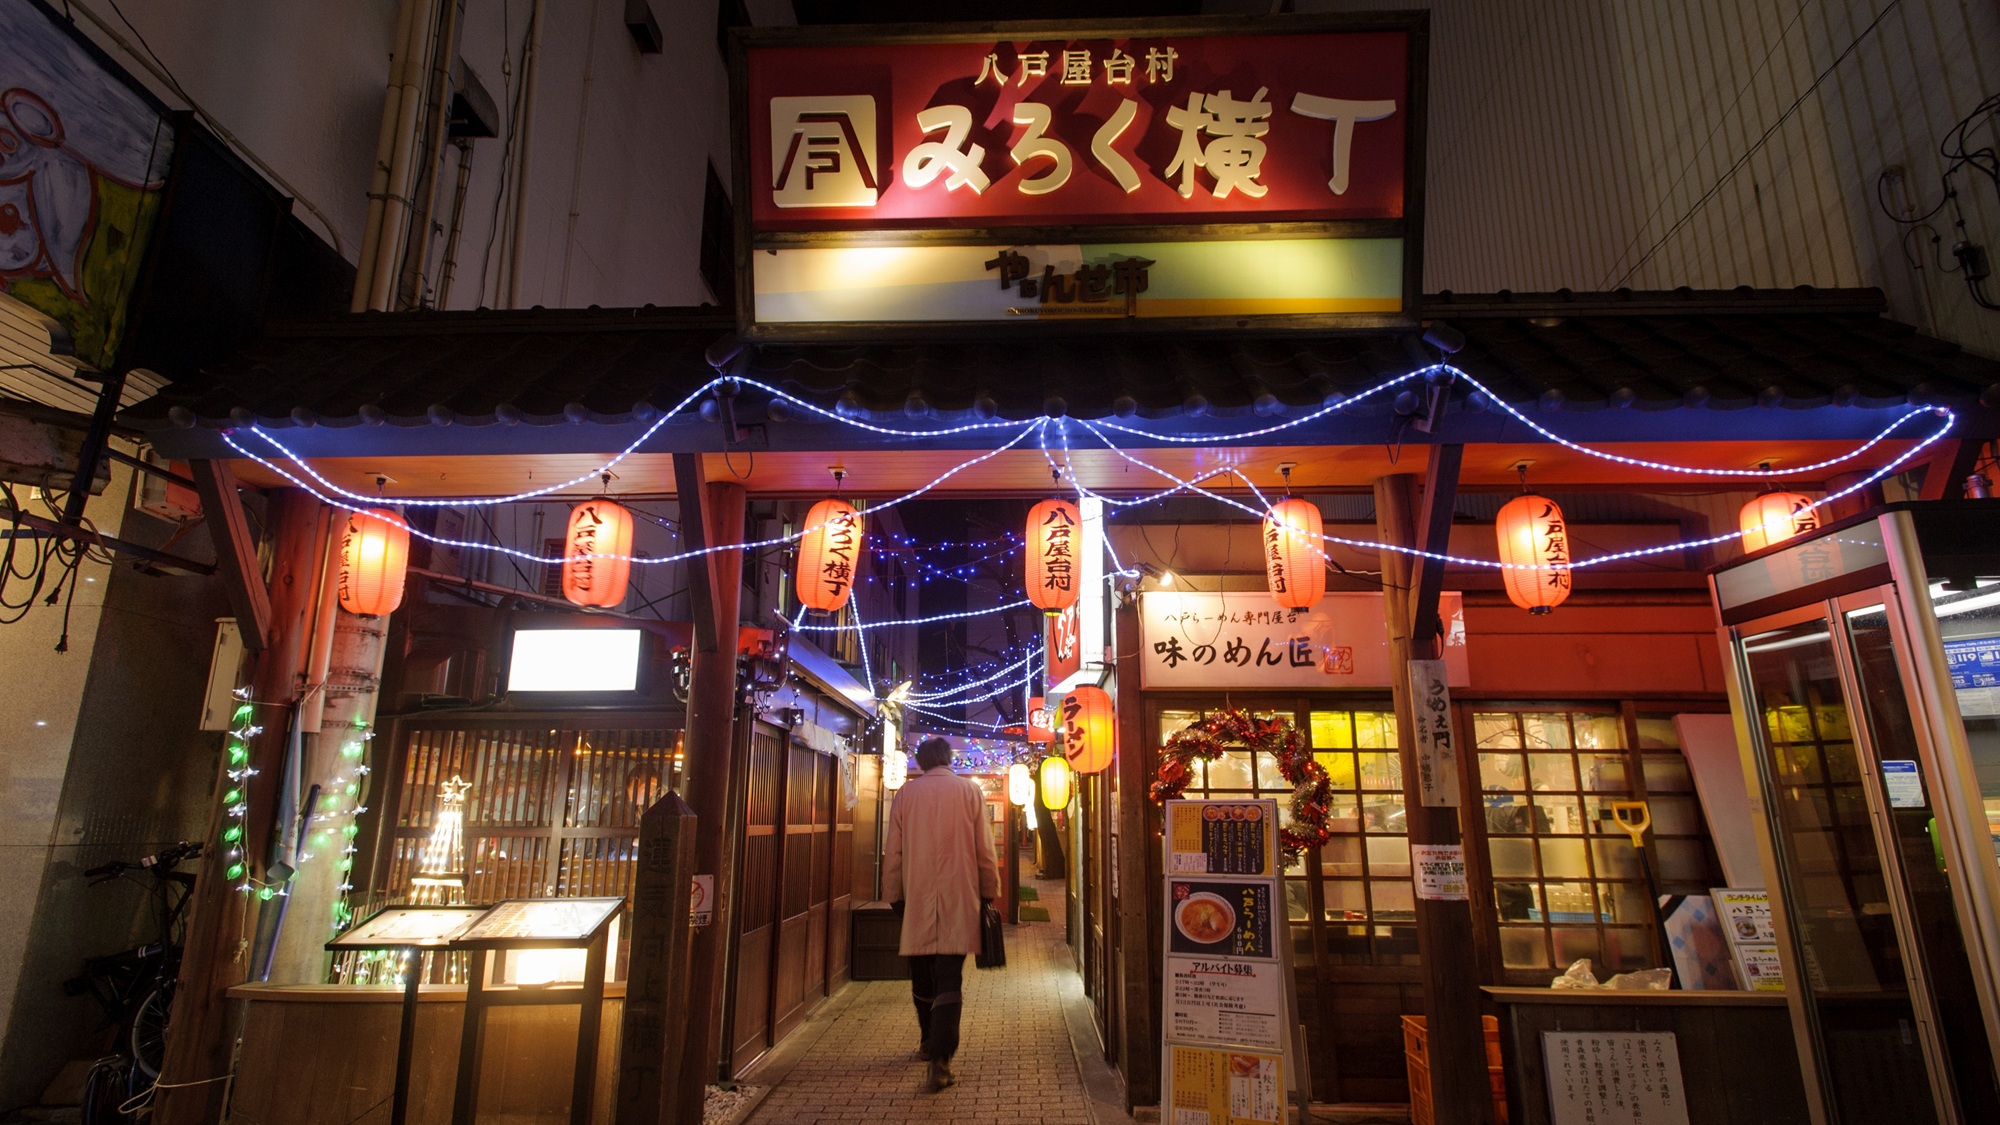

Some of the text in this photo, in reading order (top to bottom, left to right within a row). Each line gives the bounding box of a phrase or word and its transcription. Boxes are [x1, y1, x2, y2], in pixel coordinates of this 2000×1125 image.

[974, 46, 1179, 88] 八戸屋台村
[902, 86, 1397, 199] みろく横丁
[822, 510, 857, 596] みろく横丁
[1043, 507, 1074, 591] 八戸屋台村
[1164, 611, 1298, 626] 八戸らーめん専門屋台
[1153, 635, 1317, 669] 味のめん匠
[1957, 653, 1977, 662] 119
[1063, 695, 1086, 761] ラーメン
[1426, 679, 1451, 749] うめえ門
[1236, 926, 1245, 956] 600円
[1241, 887, 1256, 952] 八戸らーめん
[1192, 962, 1253, 975] アルバイト募集
[1637, 1039, 1653, 1093] 使用されている
[1653, 1038, 1671, 1107] みろく横丁の通路に
